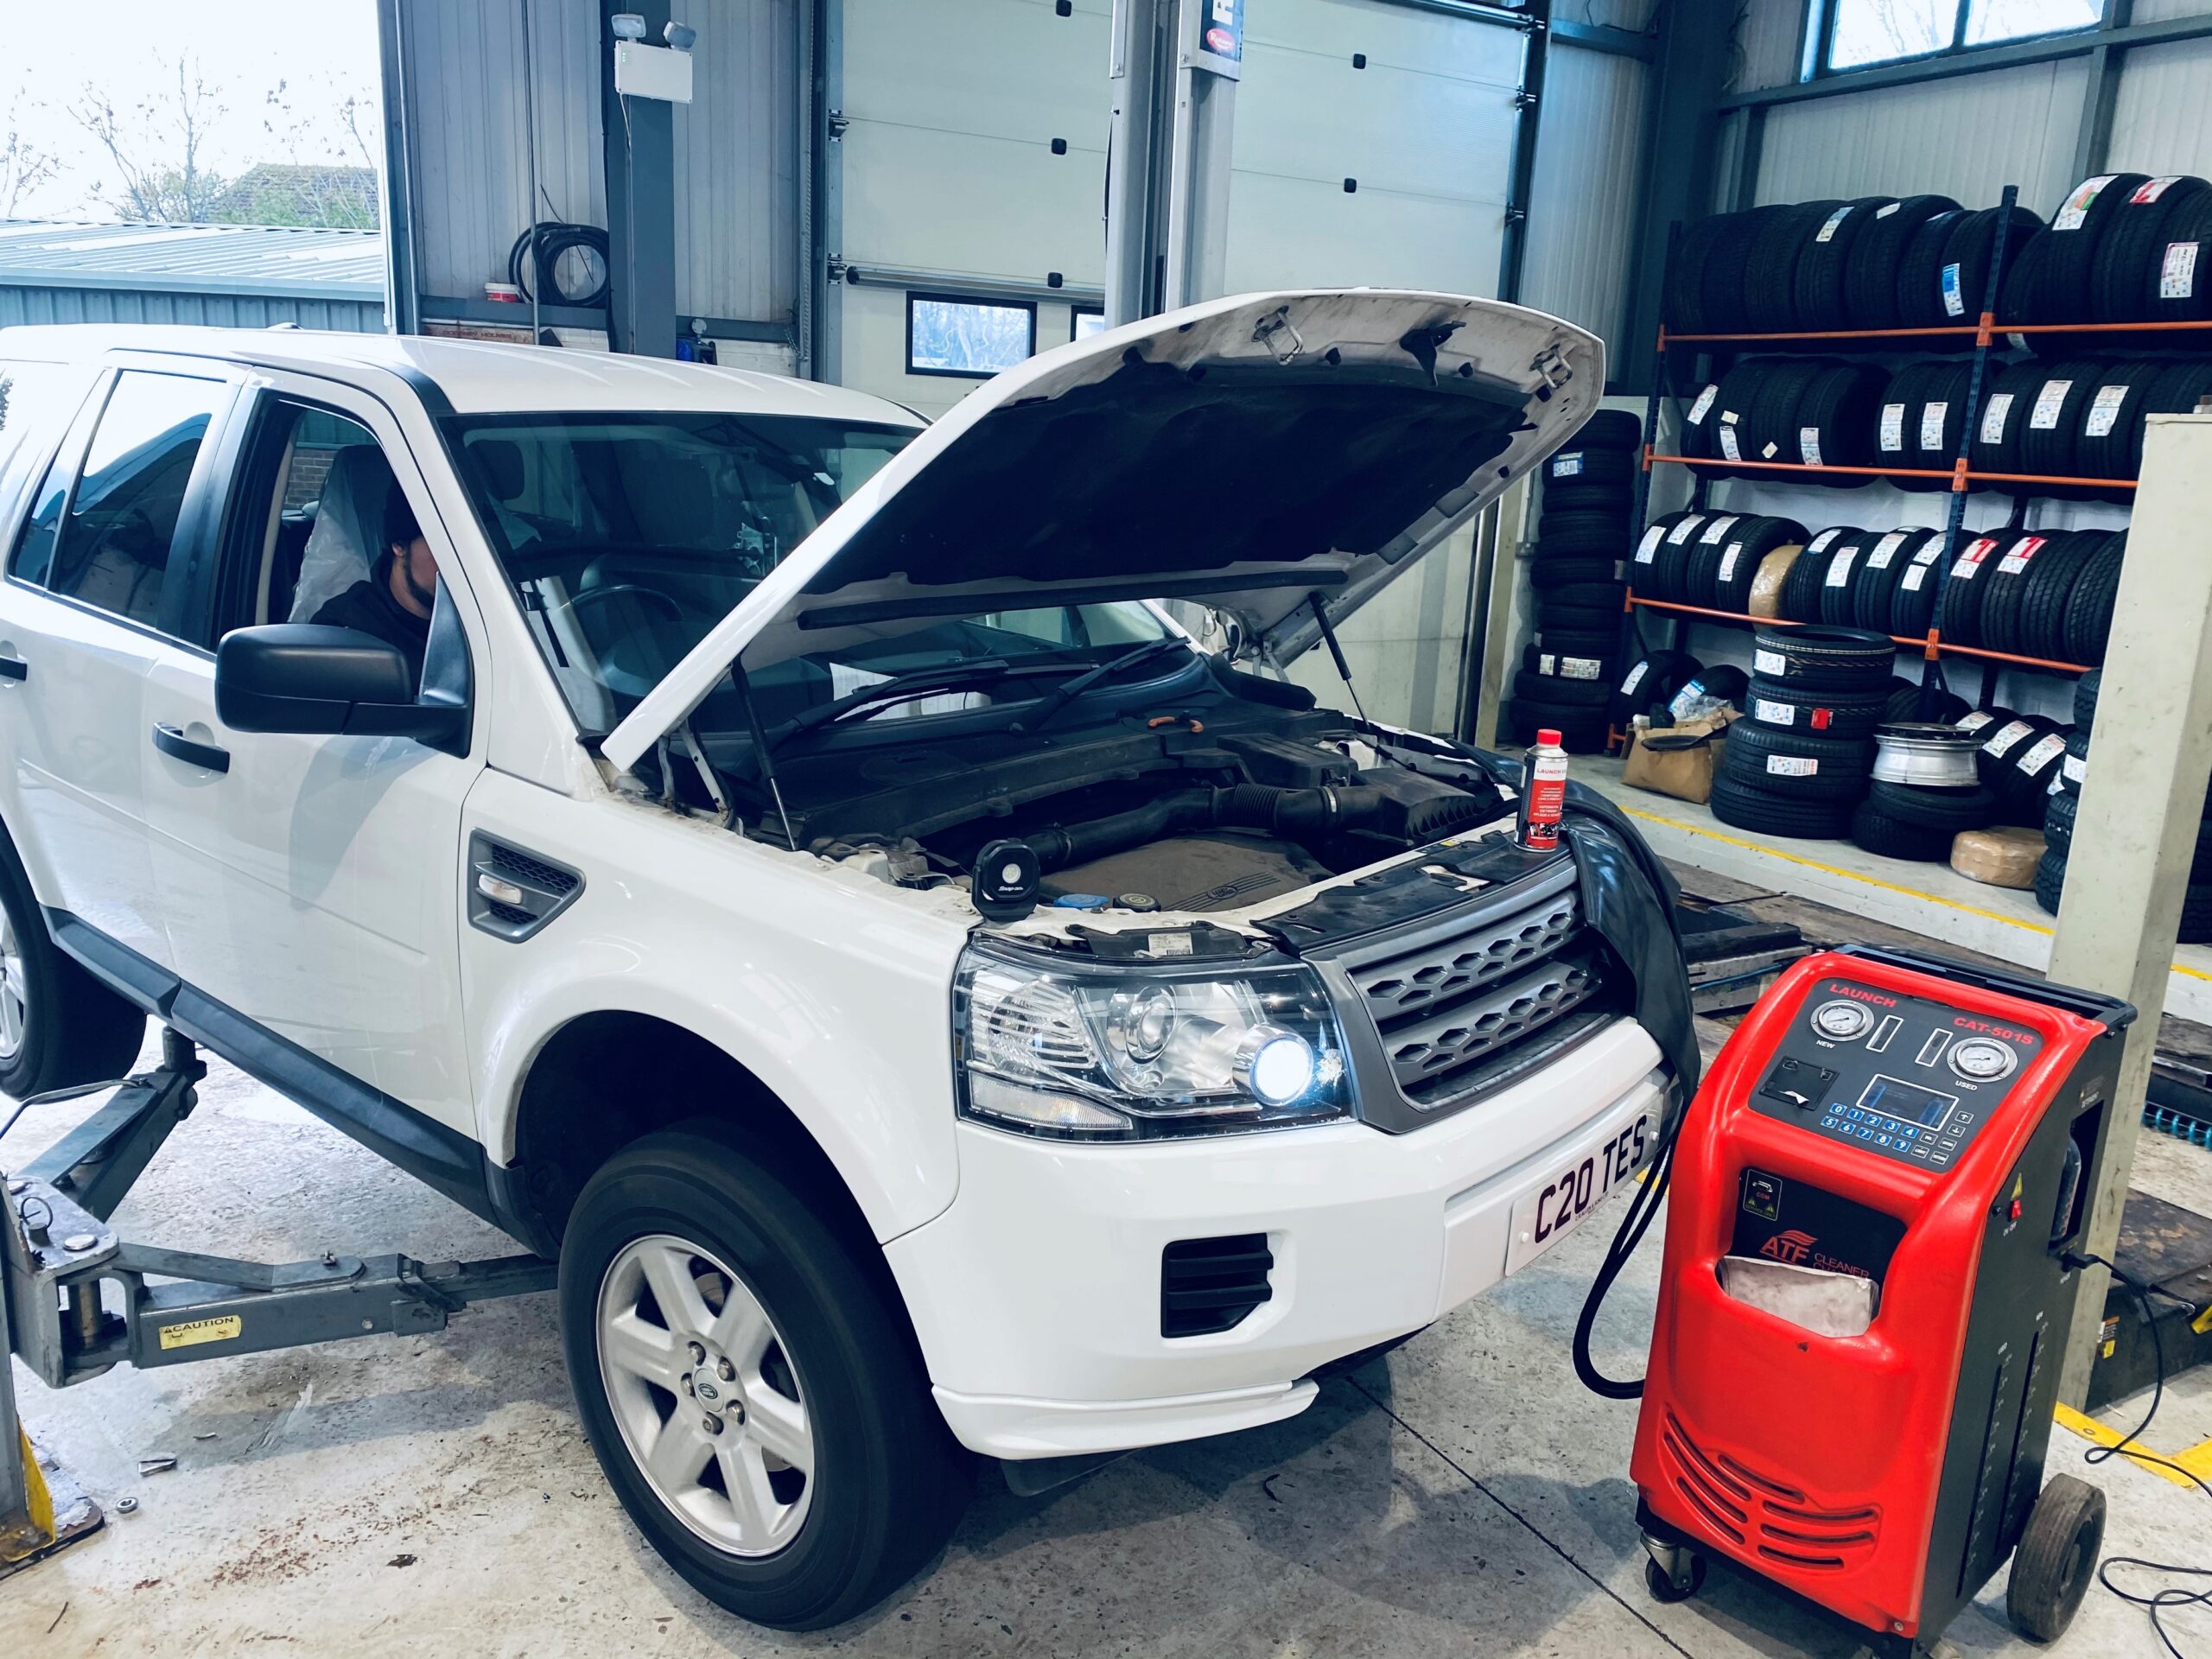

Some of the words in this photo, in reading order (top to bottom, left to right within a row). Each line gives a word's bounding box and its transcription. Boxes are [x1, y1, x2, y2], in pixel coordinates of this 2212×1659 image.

[1829, 984, 1897, 1007] LAUNCH
[1954, 1017, 2033, 1045] CAT-501S
[1815, 1039, 1836, 1049] NEW
[1955, 1080, 1978, 1091] USED
[1534, 1156, 1594, 1244] C20
[1602, 1114, 1648, 1194] TES
[1761, 1236, 1810, 1262] ATF
[1814, 1252, 1870, 1279] CLEANER
[172, 1316, 234, 1332] CAUTION
